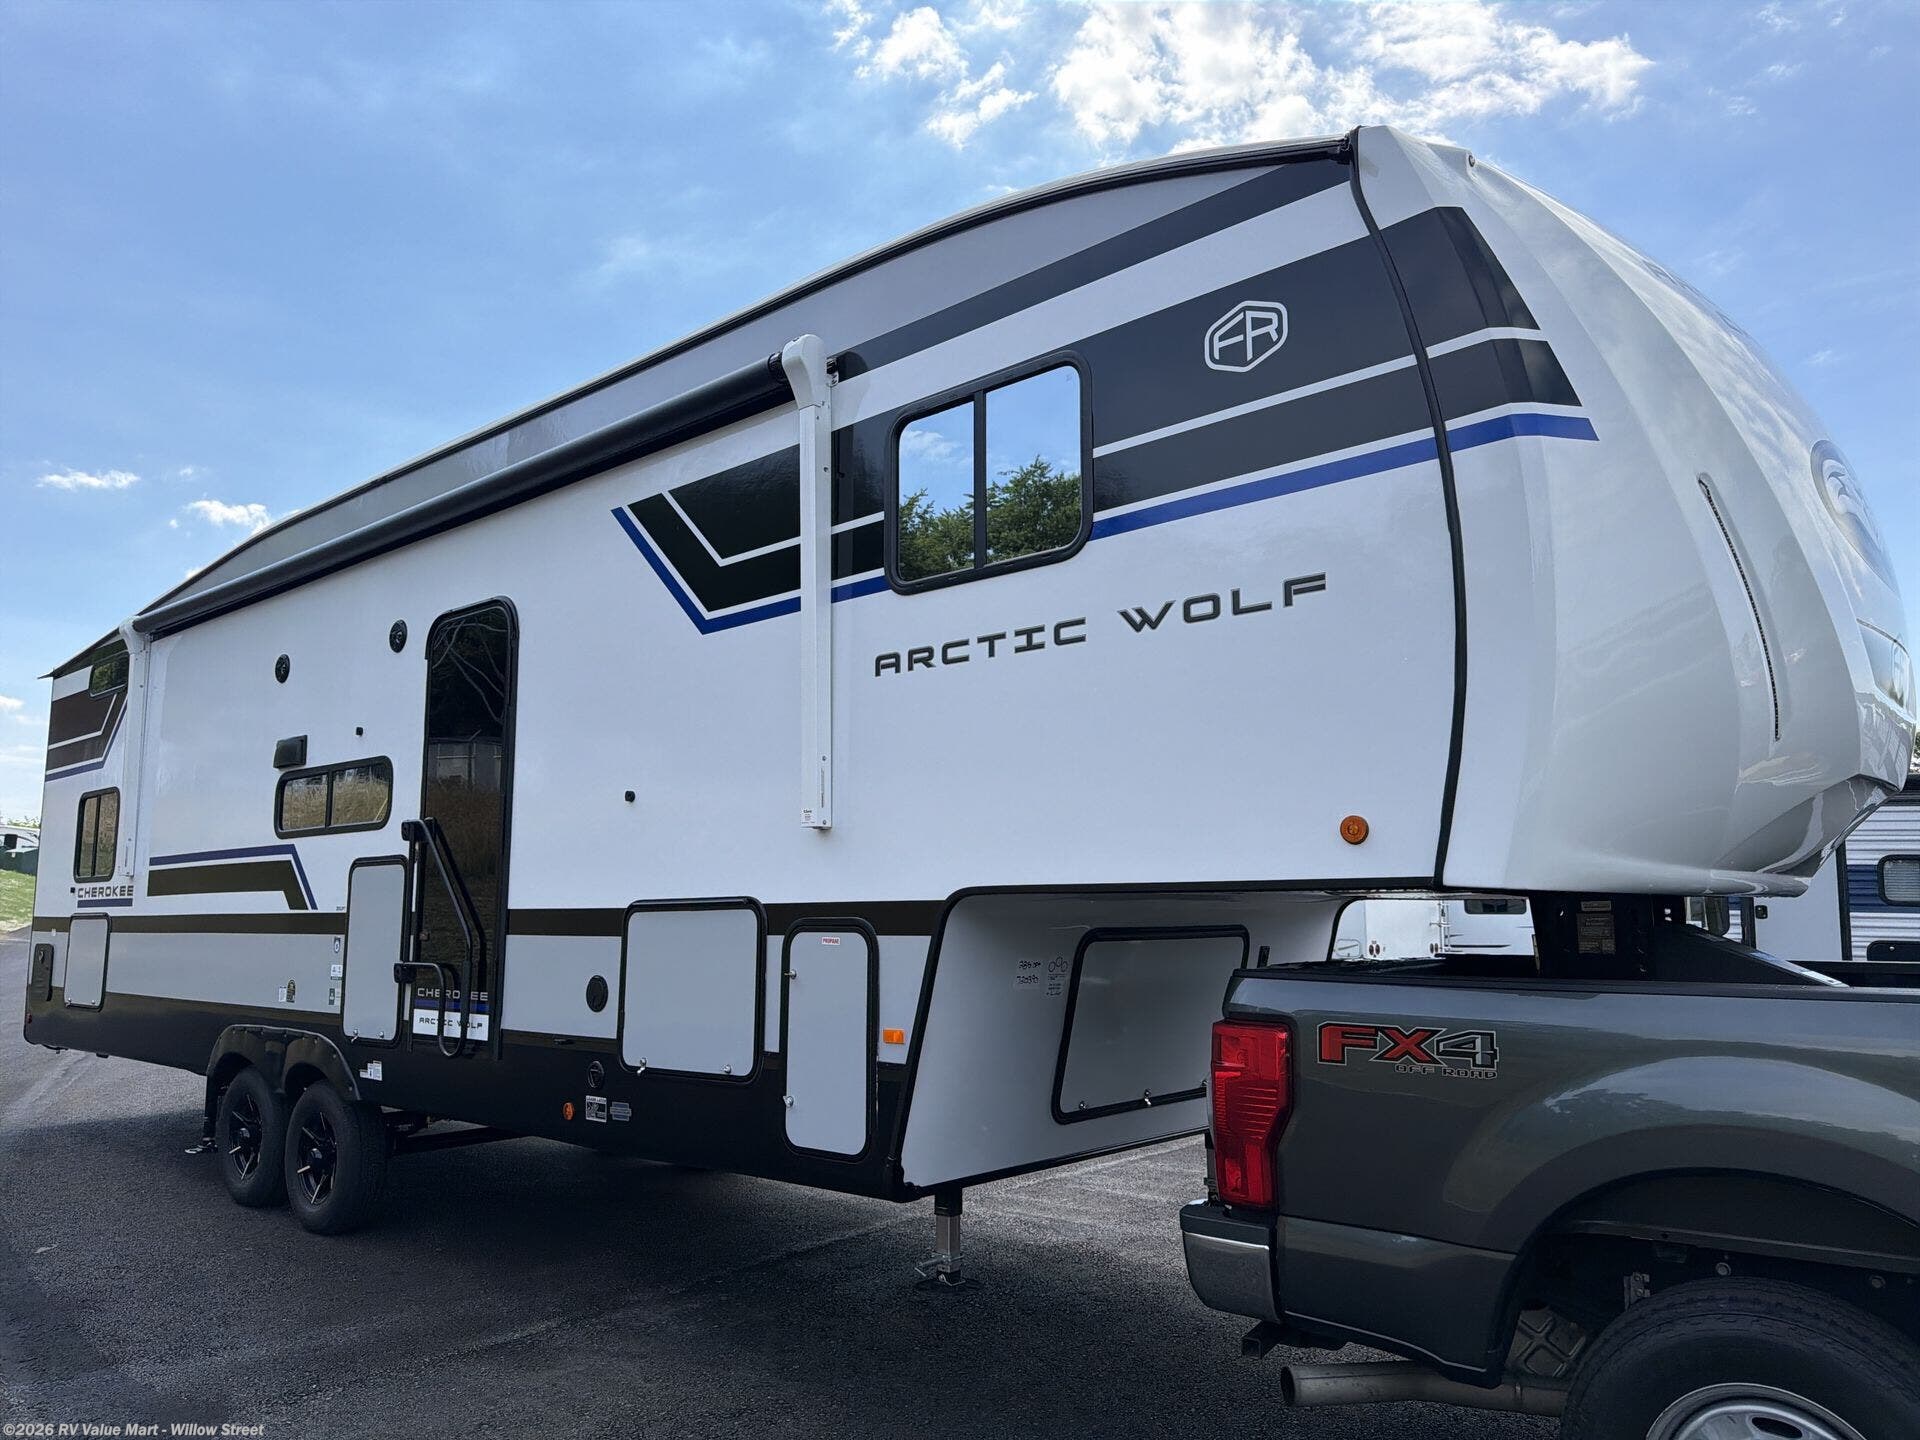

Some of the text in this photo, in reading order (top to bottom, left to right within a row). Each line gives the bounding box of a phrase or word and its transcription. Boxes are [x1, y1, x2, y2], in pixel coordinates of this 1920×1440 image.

[874, 572, 1327, 677] ARCTIC WOLF
[77, 885, 134, 898] CHEROKEE
[417, 988, 488, 1001] CHEROEE
[1317, 1021, 1499, 1069] FX4
[1395, 1064, 1497, 1079] OFF ROAD
